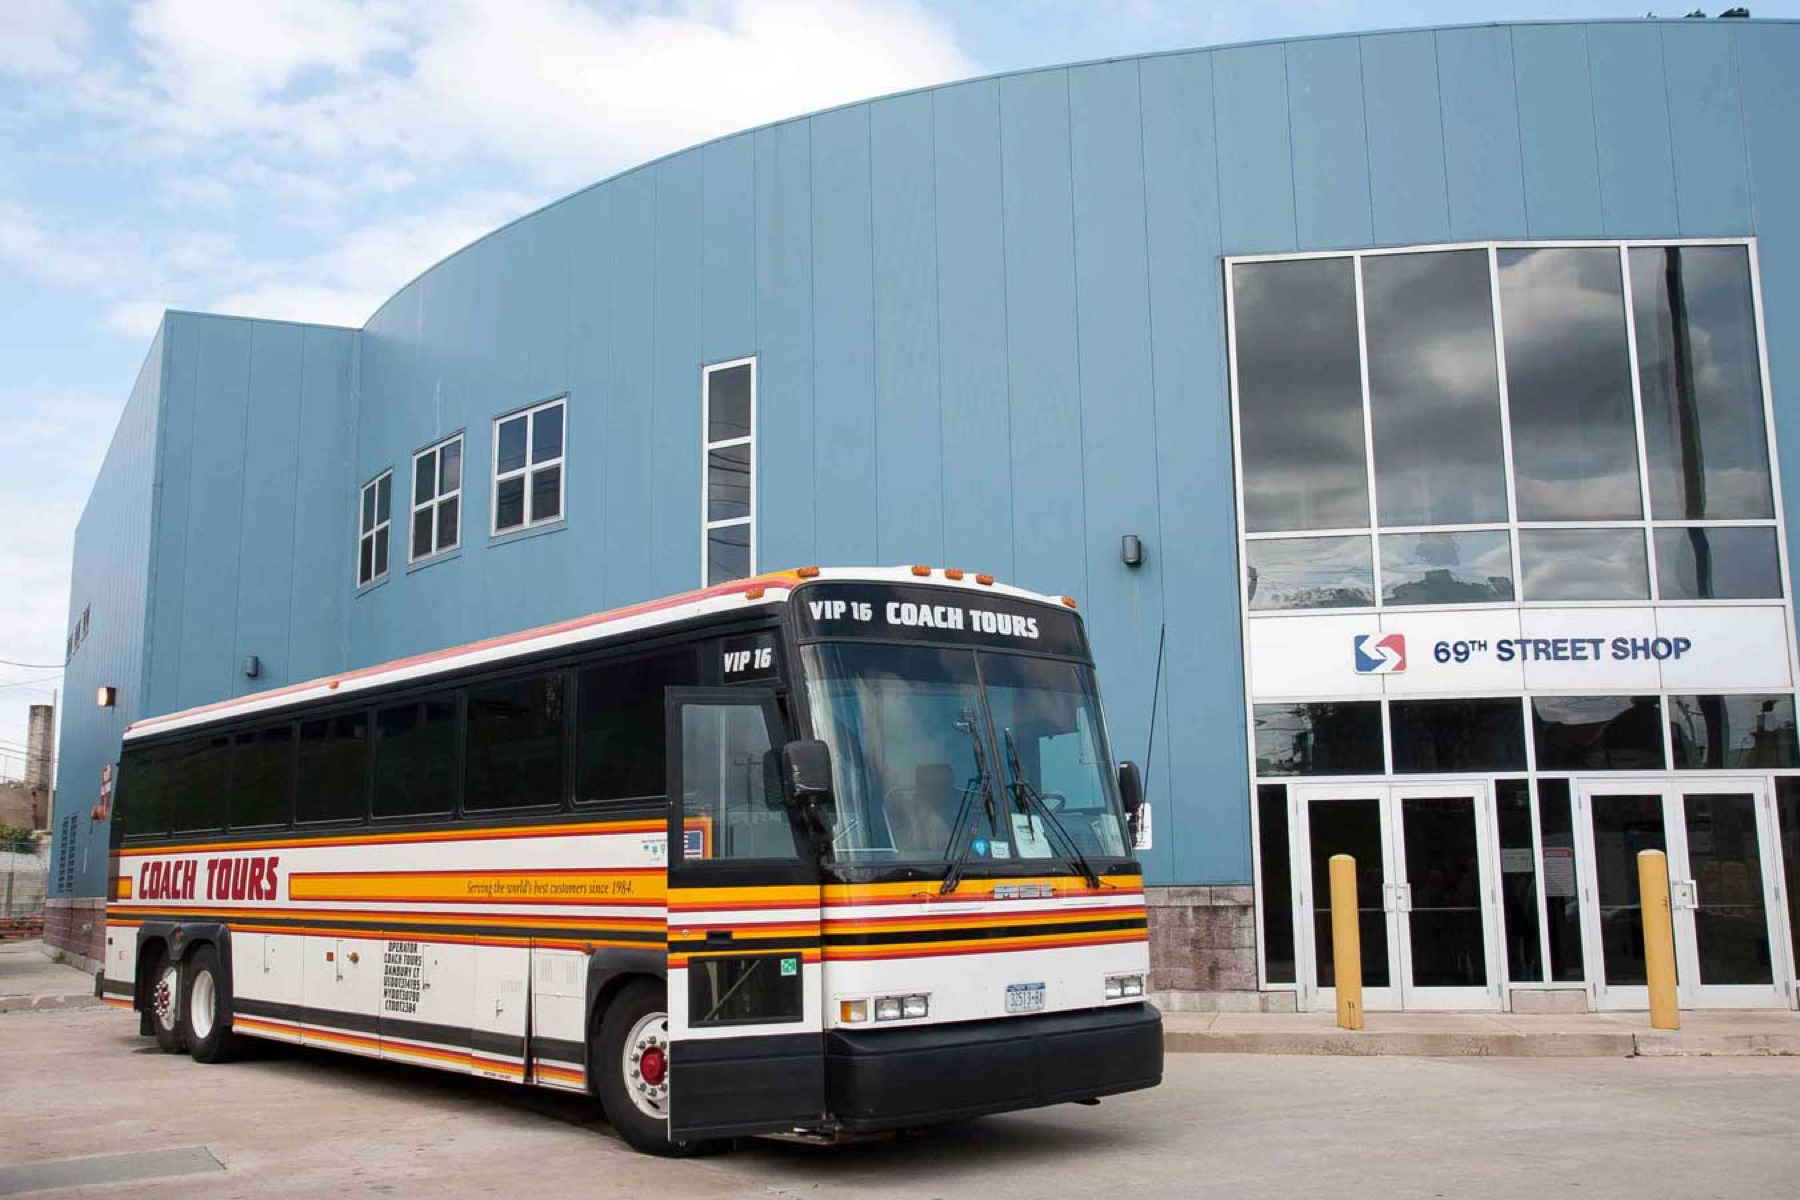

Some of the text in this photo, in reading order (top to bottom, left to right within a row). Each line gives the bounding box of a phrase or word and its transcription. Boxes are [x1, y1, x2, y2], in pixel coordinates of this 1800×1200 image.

[808, 601, 1039, 639] VIP 16 COACH TOURS
[724, 647, 772, 672] VIP 16
[1433, 636, 1692, 664] 69TH STREET SHOP
[139, 856, 279, 901] COACH TOURS
[467, 880, 493, 896] Serving
[493, 880, 505, 894] the
[506, 879, 532, 894] world's
[534, 880, 549, 894] best
[550, 880, 587, 895] customers
[589, 880, 609, 894] since
[388, 942, 418, 953] OPERATOR
[384, 953, 422, 966] COACH TOURS
[384, 965, 420, 978] DANBURY CT
